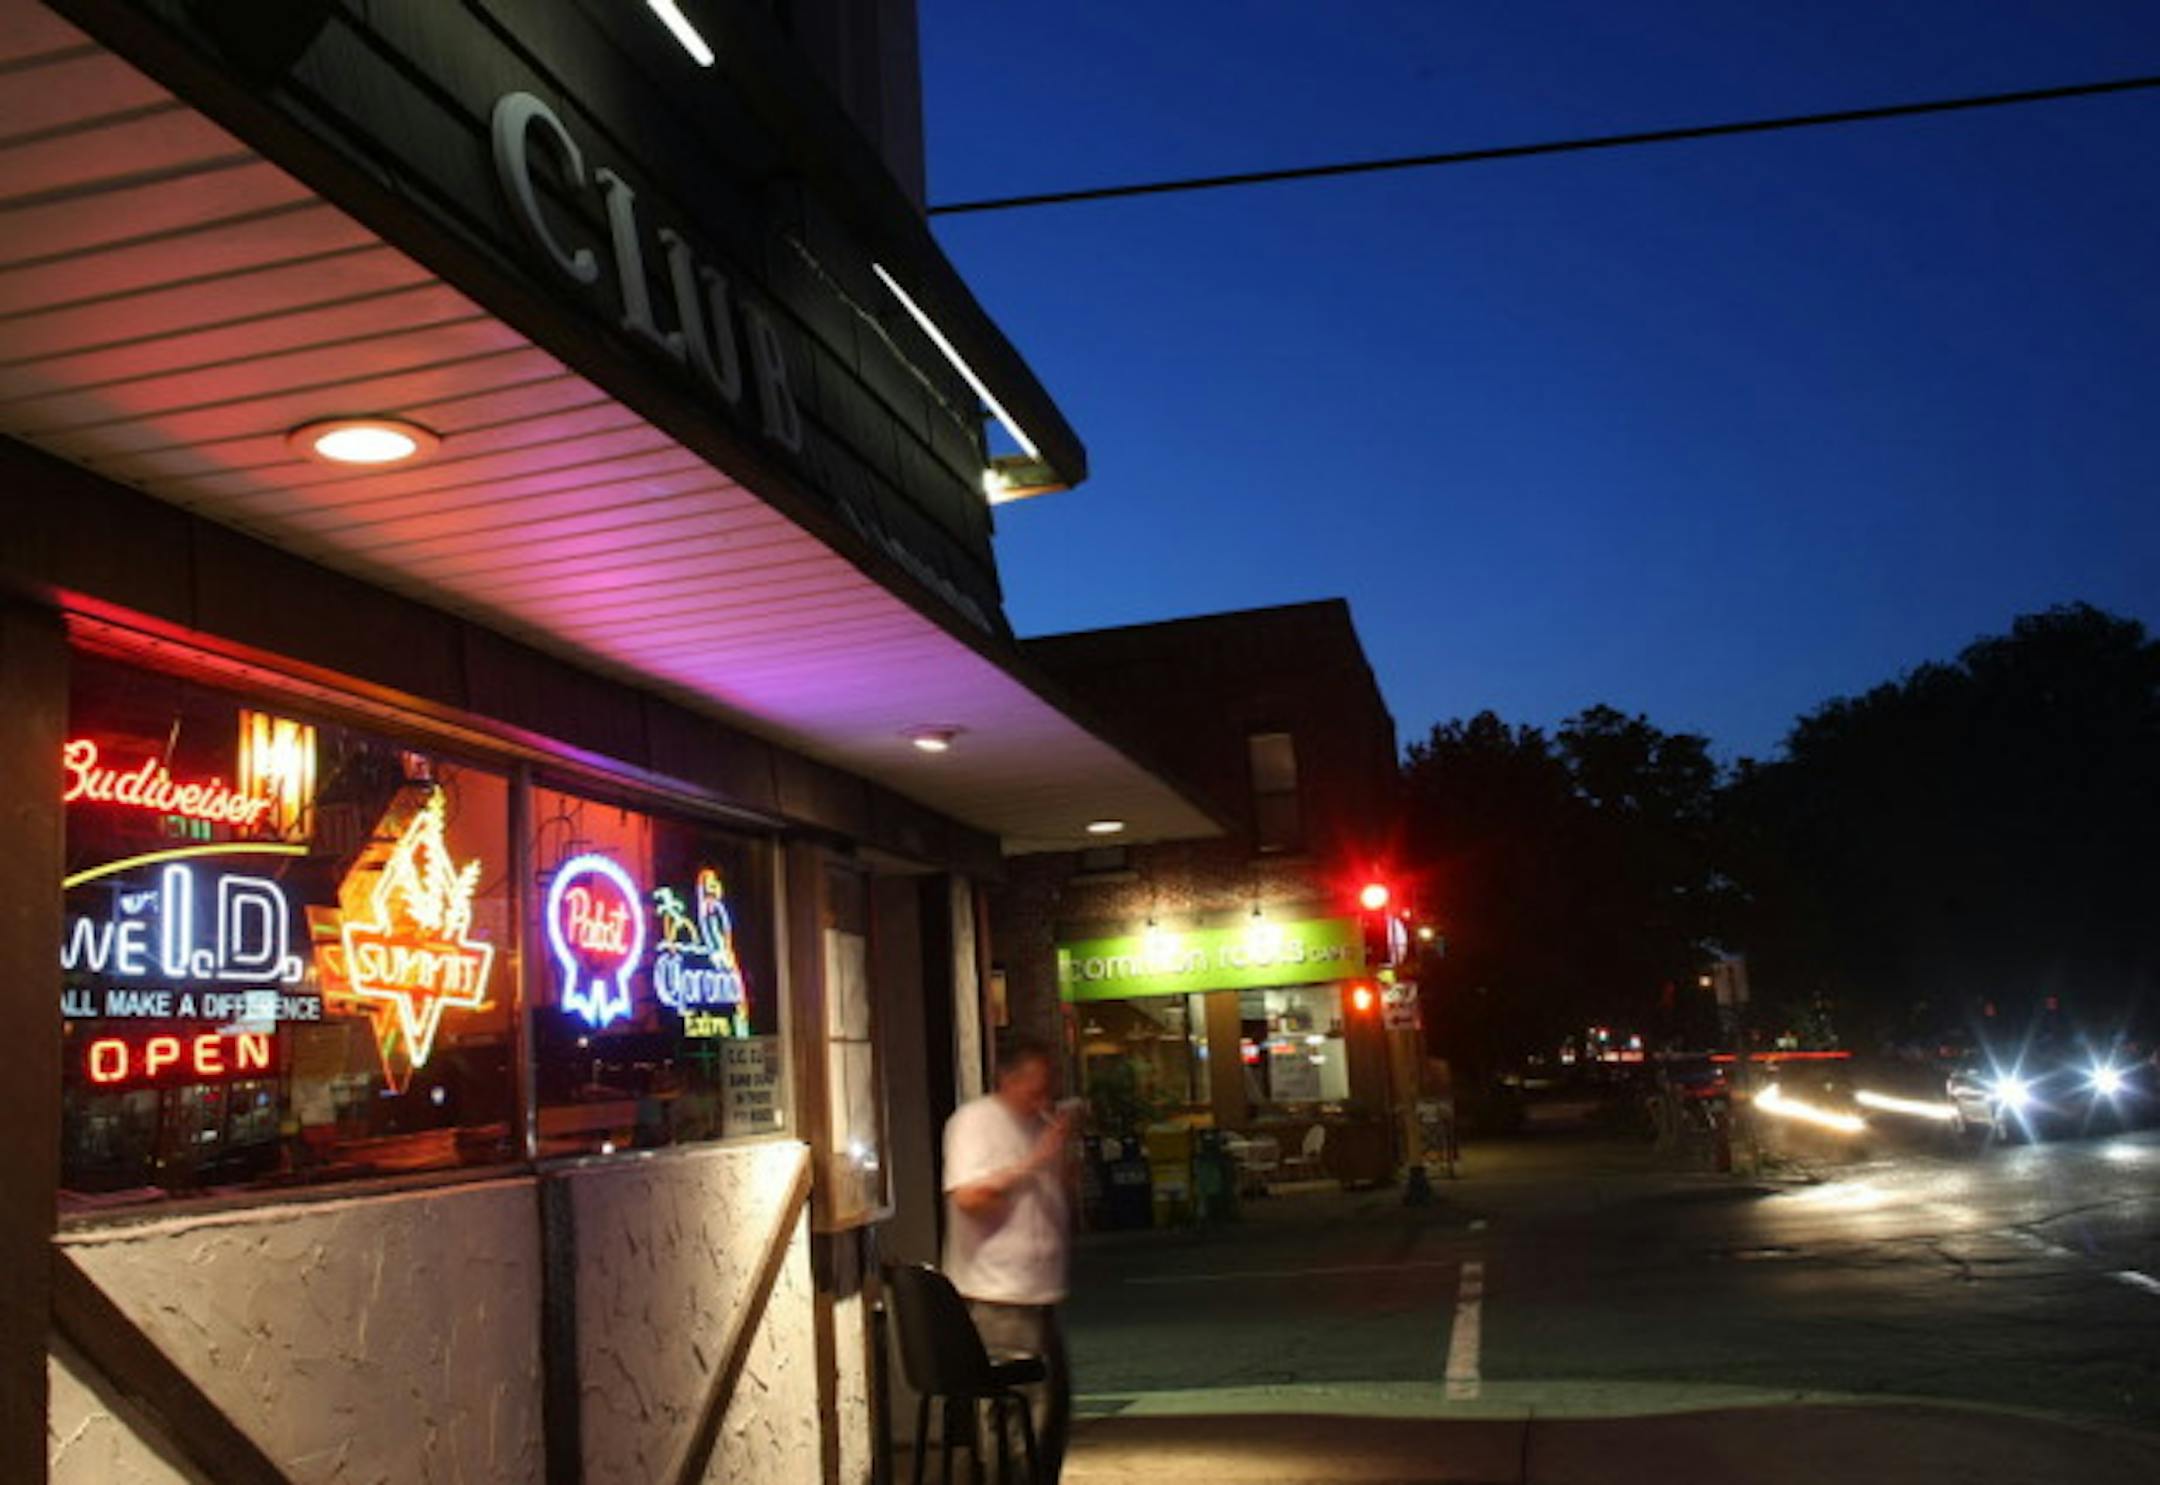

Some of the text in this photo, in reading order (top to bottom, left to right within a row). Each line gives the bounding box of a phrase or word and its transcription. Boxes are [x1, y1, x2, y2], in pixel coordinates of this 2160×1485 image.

[492, 92, 800, 454] CLUB
[62, 739, 271, 824] Budweiser
[565, 886, 630, 955] Pabst
[358, 943, 478, 994] SUMMIT
[1059, 946, 1209, 984] comon
[1218, 940, 1305, 968] roos
[106, 989, 172, 1017] MAKE
[177, 991, 197, 1017] A
[203, 991, 321, 1020] DIFFENCE
[90, 1032, 271, 1083] OPEN
